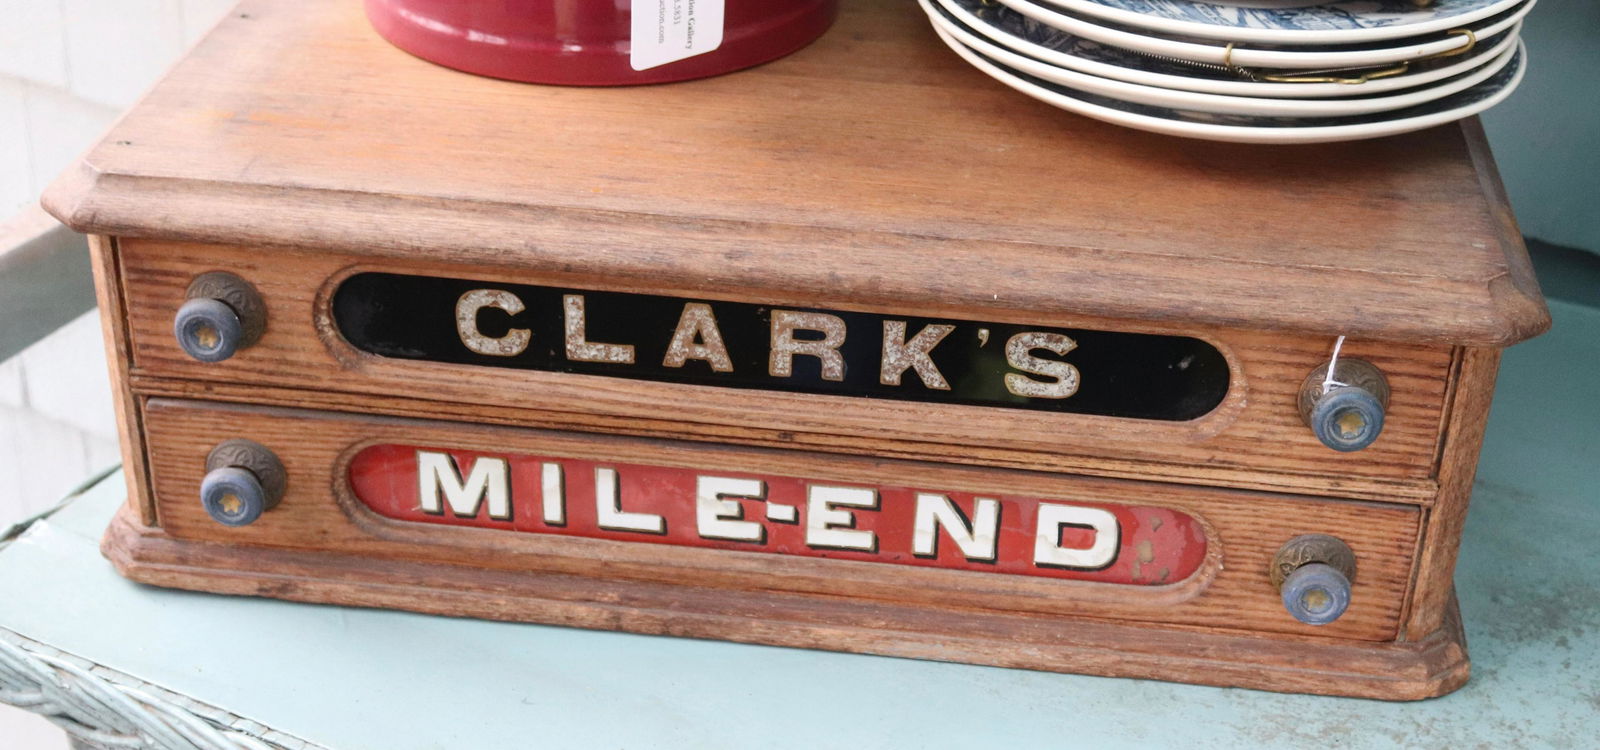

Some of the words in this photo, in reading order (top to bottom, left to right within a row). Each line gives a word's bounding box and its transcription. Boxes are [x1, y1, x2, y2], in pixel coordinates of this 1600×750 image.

[685, 17, 696, 49] Gallery
[455, 288, 1081, 400] CLARK'S
[415, 450, 1122, 572] MILE-END
